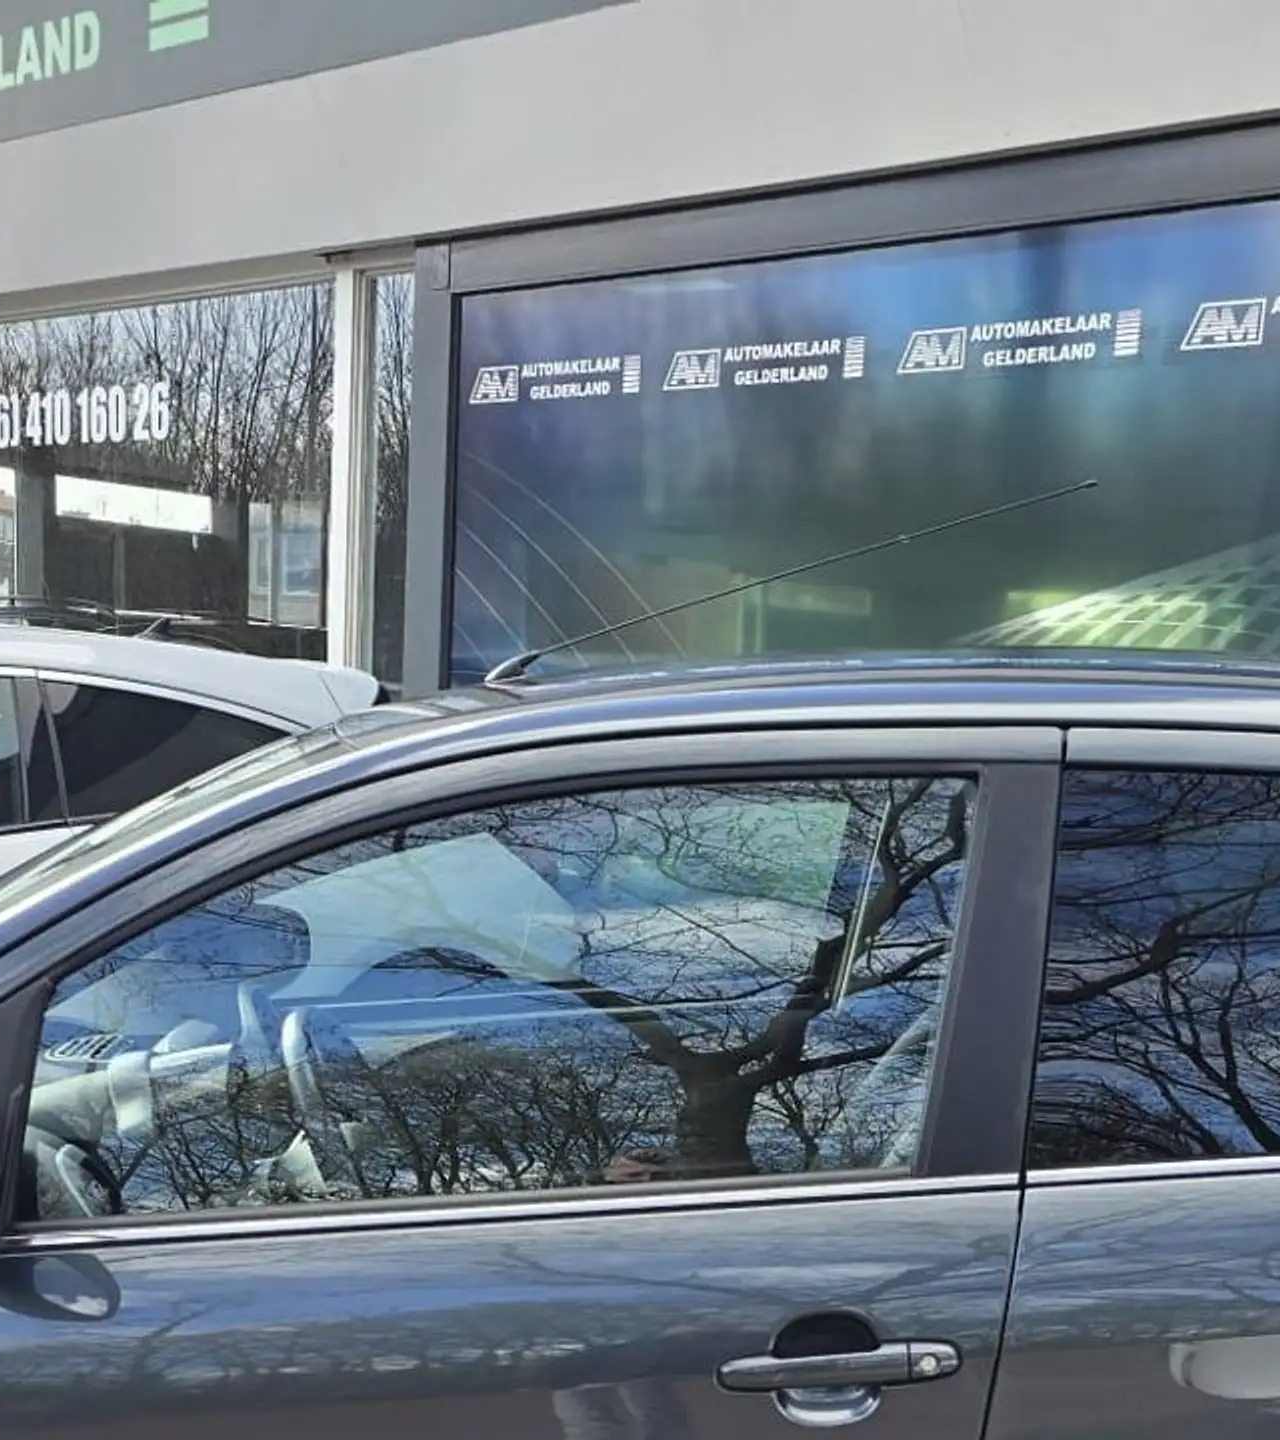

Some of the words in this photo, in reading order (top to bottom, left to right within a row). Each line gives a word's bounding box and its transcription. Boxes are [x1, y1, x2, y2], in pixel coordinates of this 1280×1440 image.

[970, 312, 1112, 342] AUTOMAKELAAR
[723, 338, 841, 362] AUTOMAKELAAR
[983, 342, 1096, 368] GELDERLAND
[521, 355, 621, 378] AUTOMAKELAAR
[734, 365, 828, 386] GELDERLAND
[529, 380, 611, 400] GELDERLAND
[26, 388, 70, 446] 410
[76, 385, 127, 444] 160
[132, 382, 170, 441] 26
